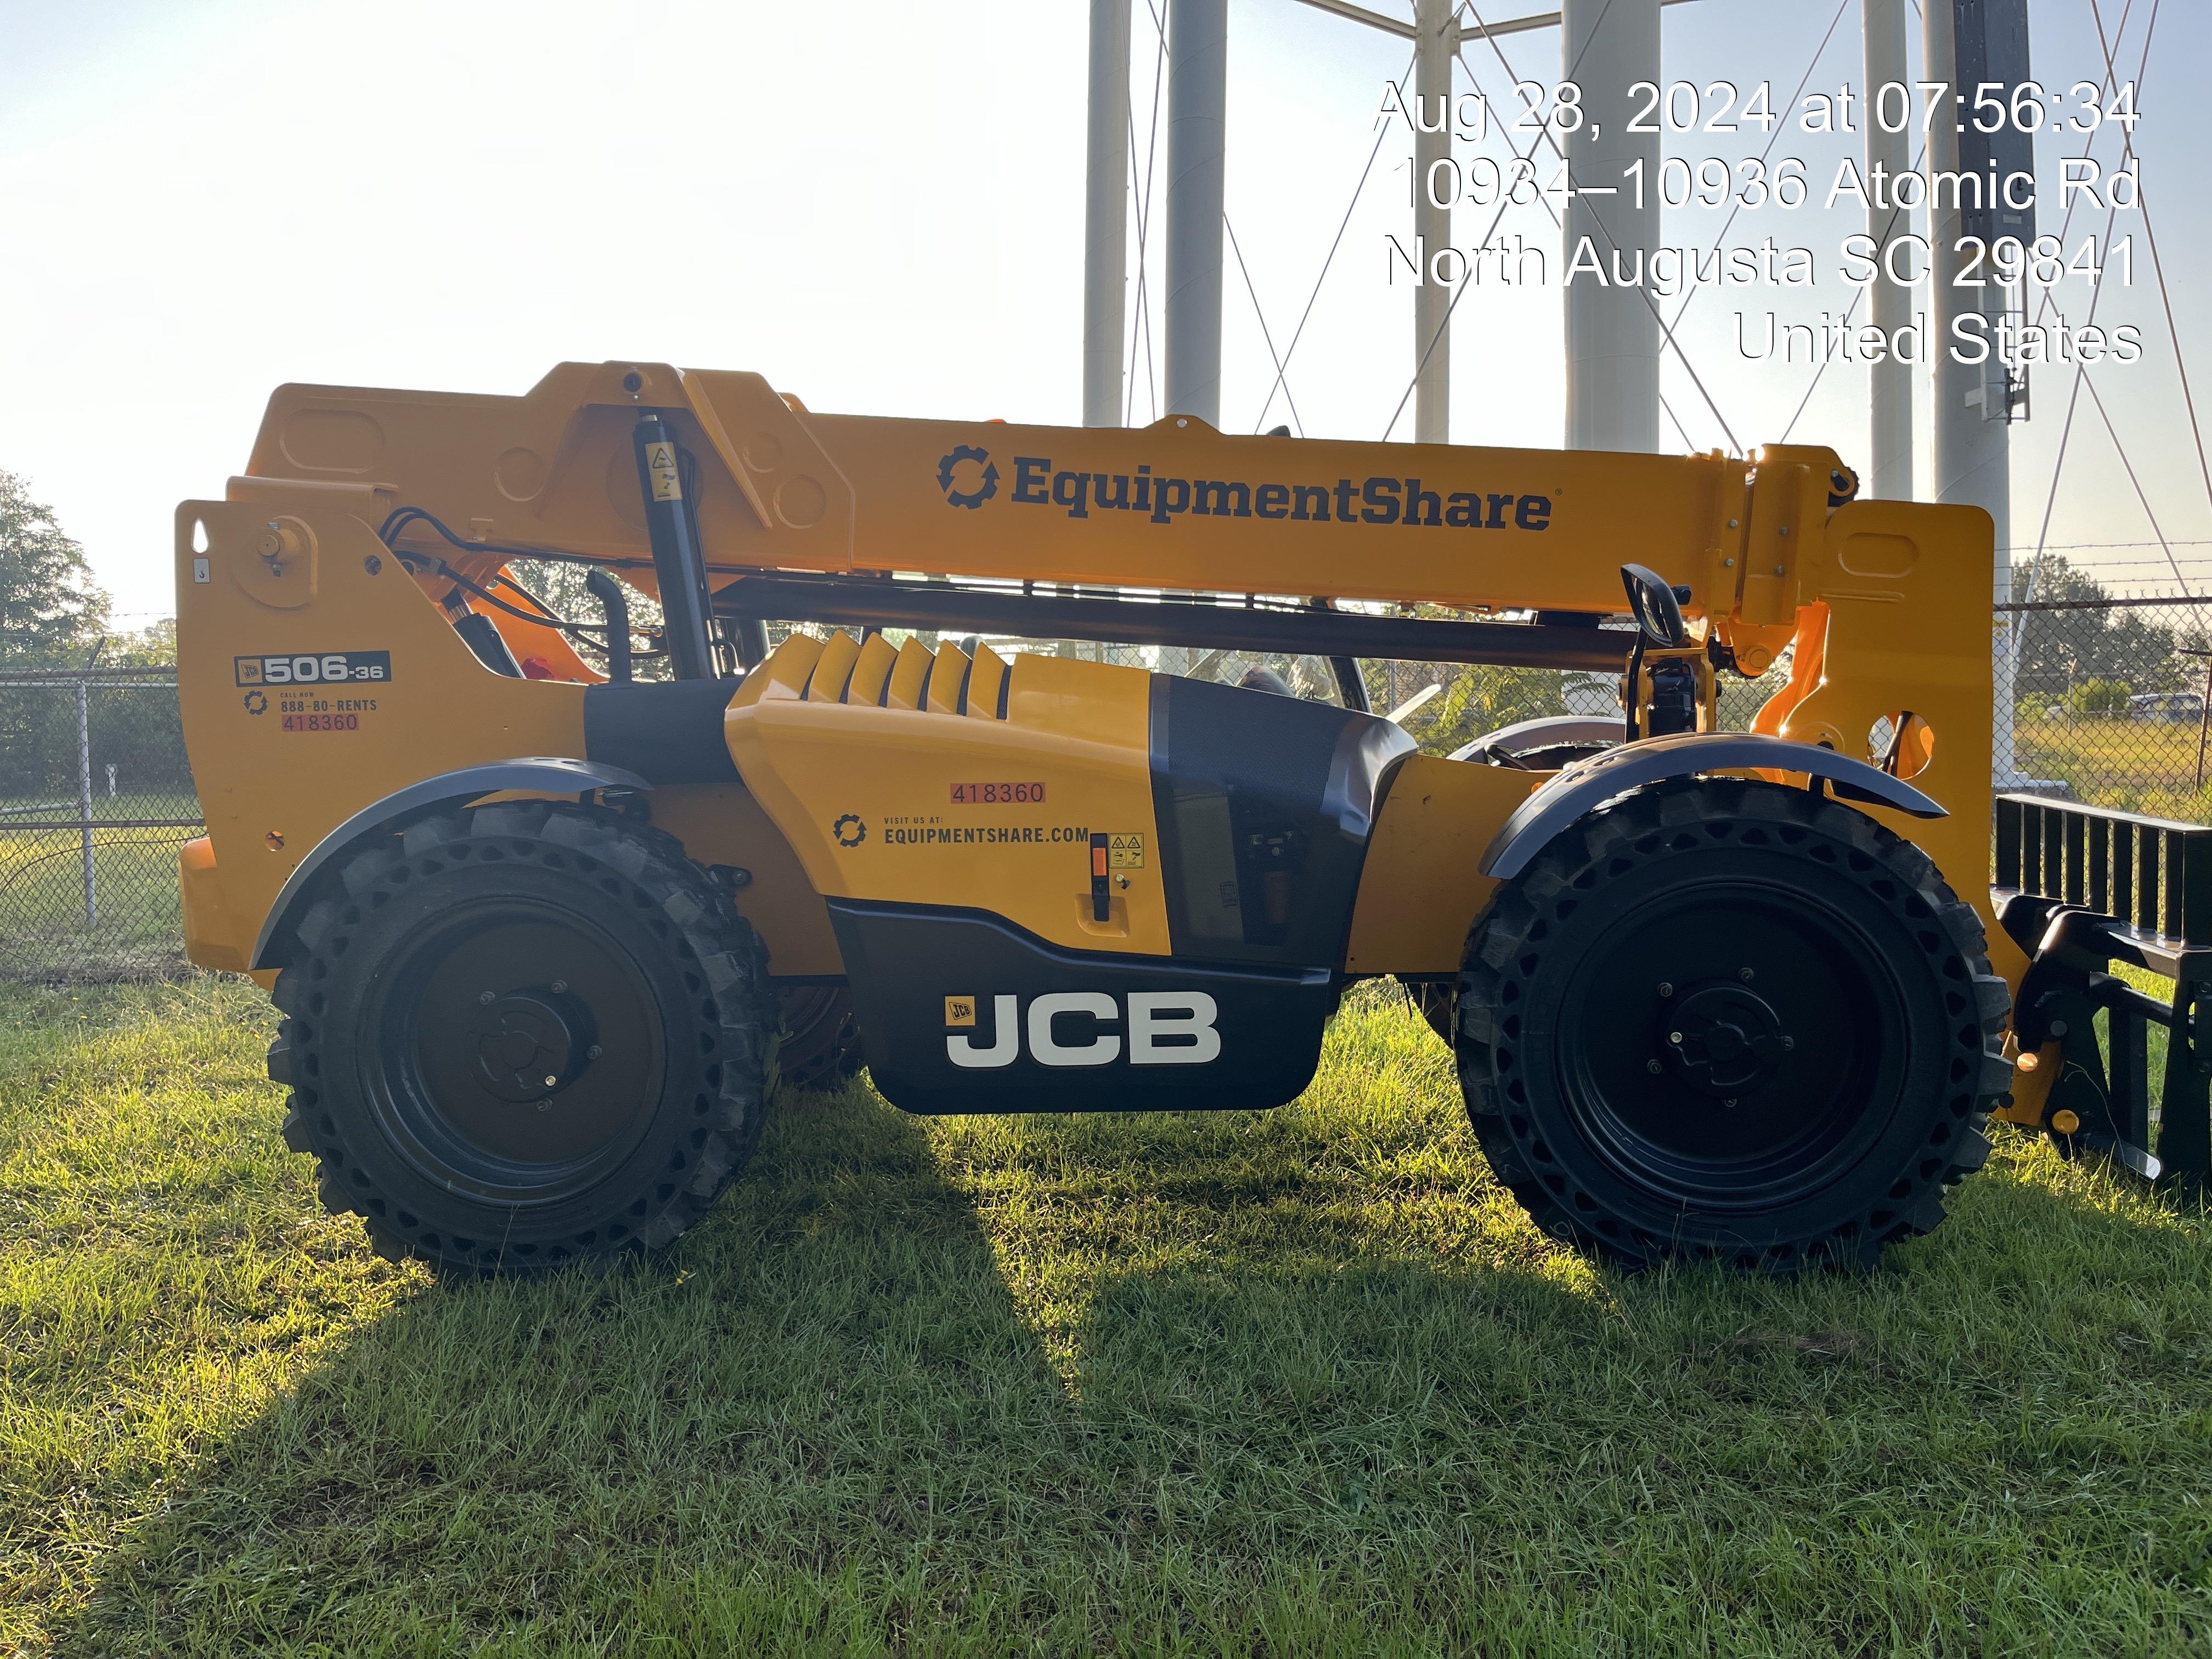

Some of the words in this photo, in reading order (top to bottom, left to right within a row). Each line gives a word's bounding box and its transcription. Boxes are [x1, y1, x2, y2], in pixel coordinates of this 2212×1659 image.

[1012, 456, 1552, 531] EquipmentShare
[264, 656, 383, 683] 506-36
[281, 699, 377, 712] 888-80-RENTS
[284, 714, 357, 731] 418360
[953, 783, 1043, 803] 418360
[884, 827, 1088, 844] EQUIPMENTSHARE.COM
[952, 1003, 971, 1019] JCB
[946, 991, 1221, 1068] JCB
